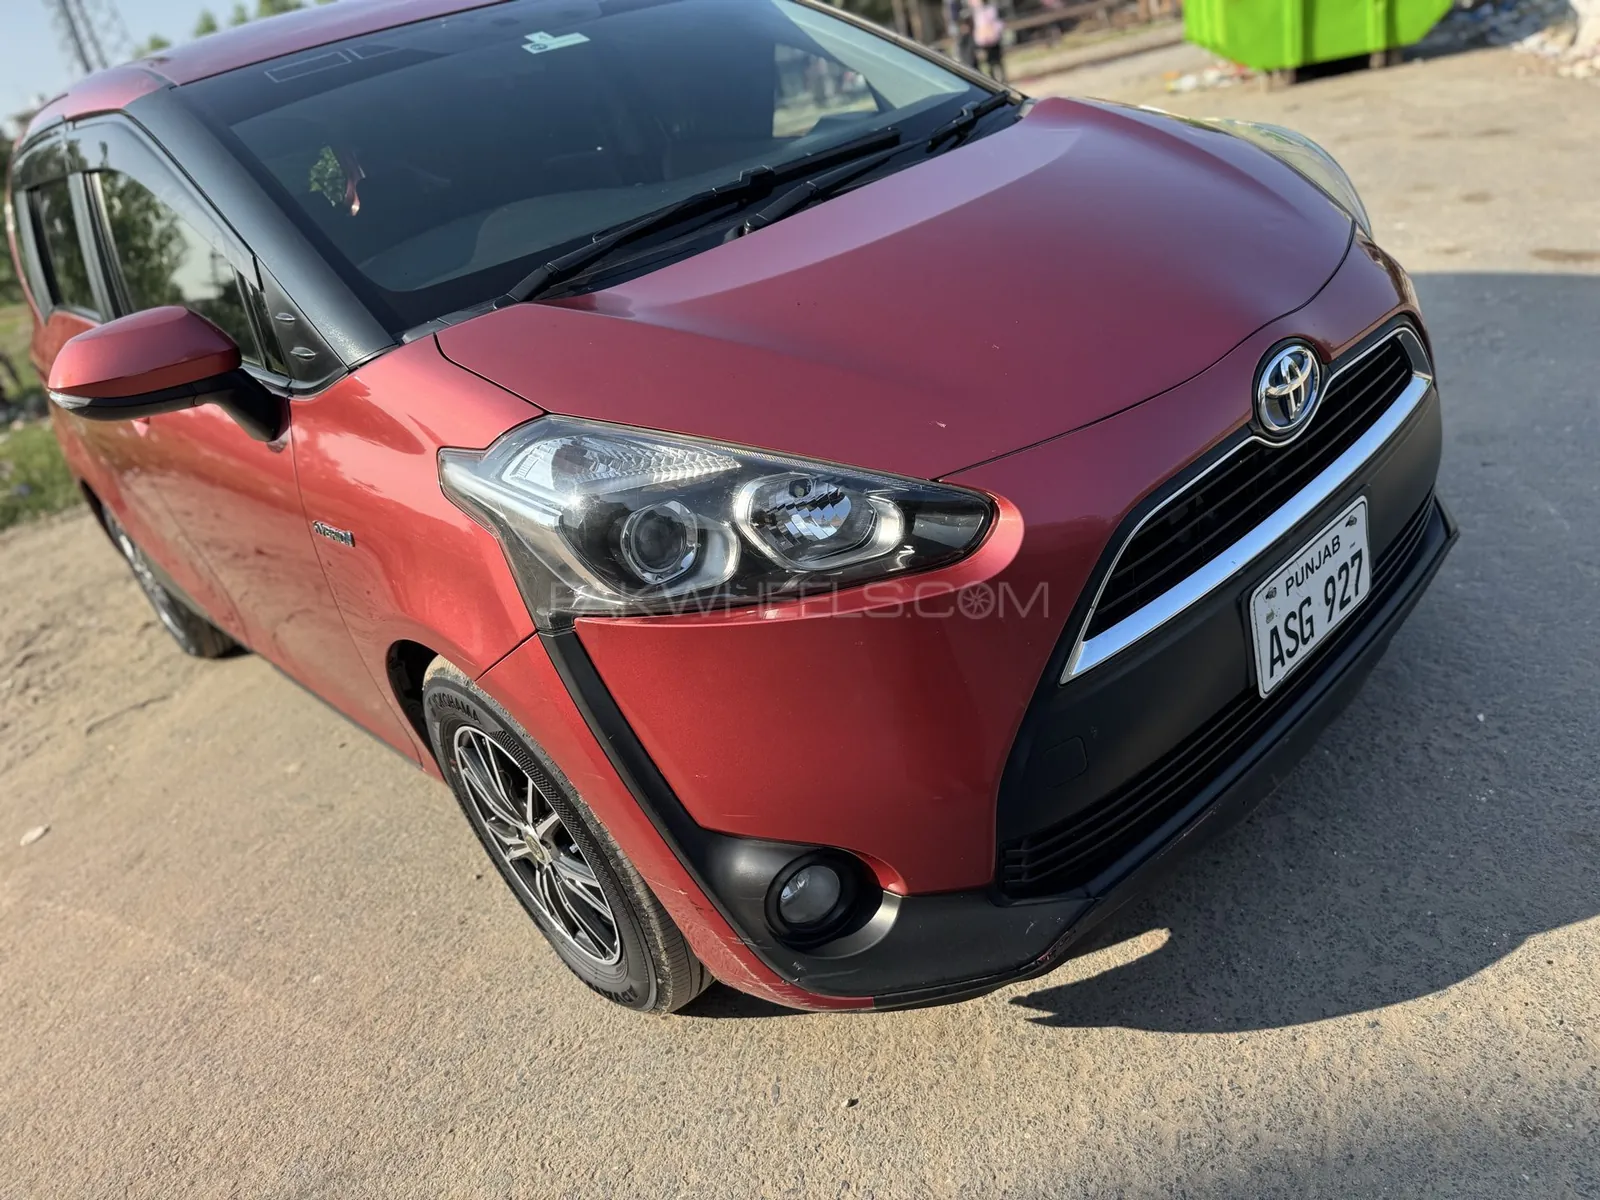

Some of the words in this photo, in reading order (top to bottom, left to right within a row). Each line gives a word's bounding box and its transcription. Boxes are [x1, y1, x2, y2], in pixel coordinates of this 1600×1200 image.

[1269, 596, 1315, 679] ASG
[1324, 548, 1363, 623] 927
[1285, 534, 1341, 597] PUNJAB
